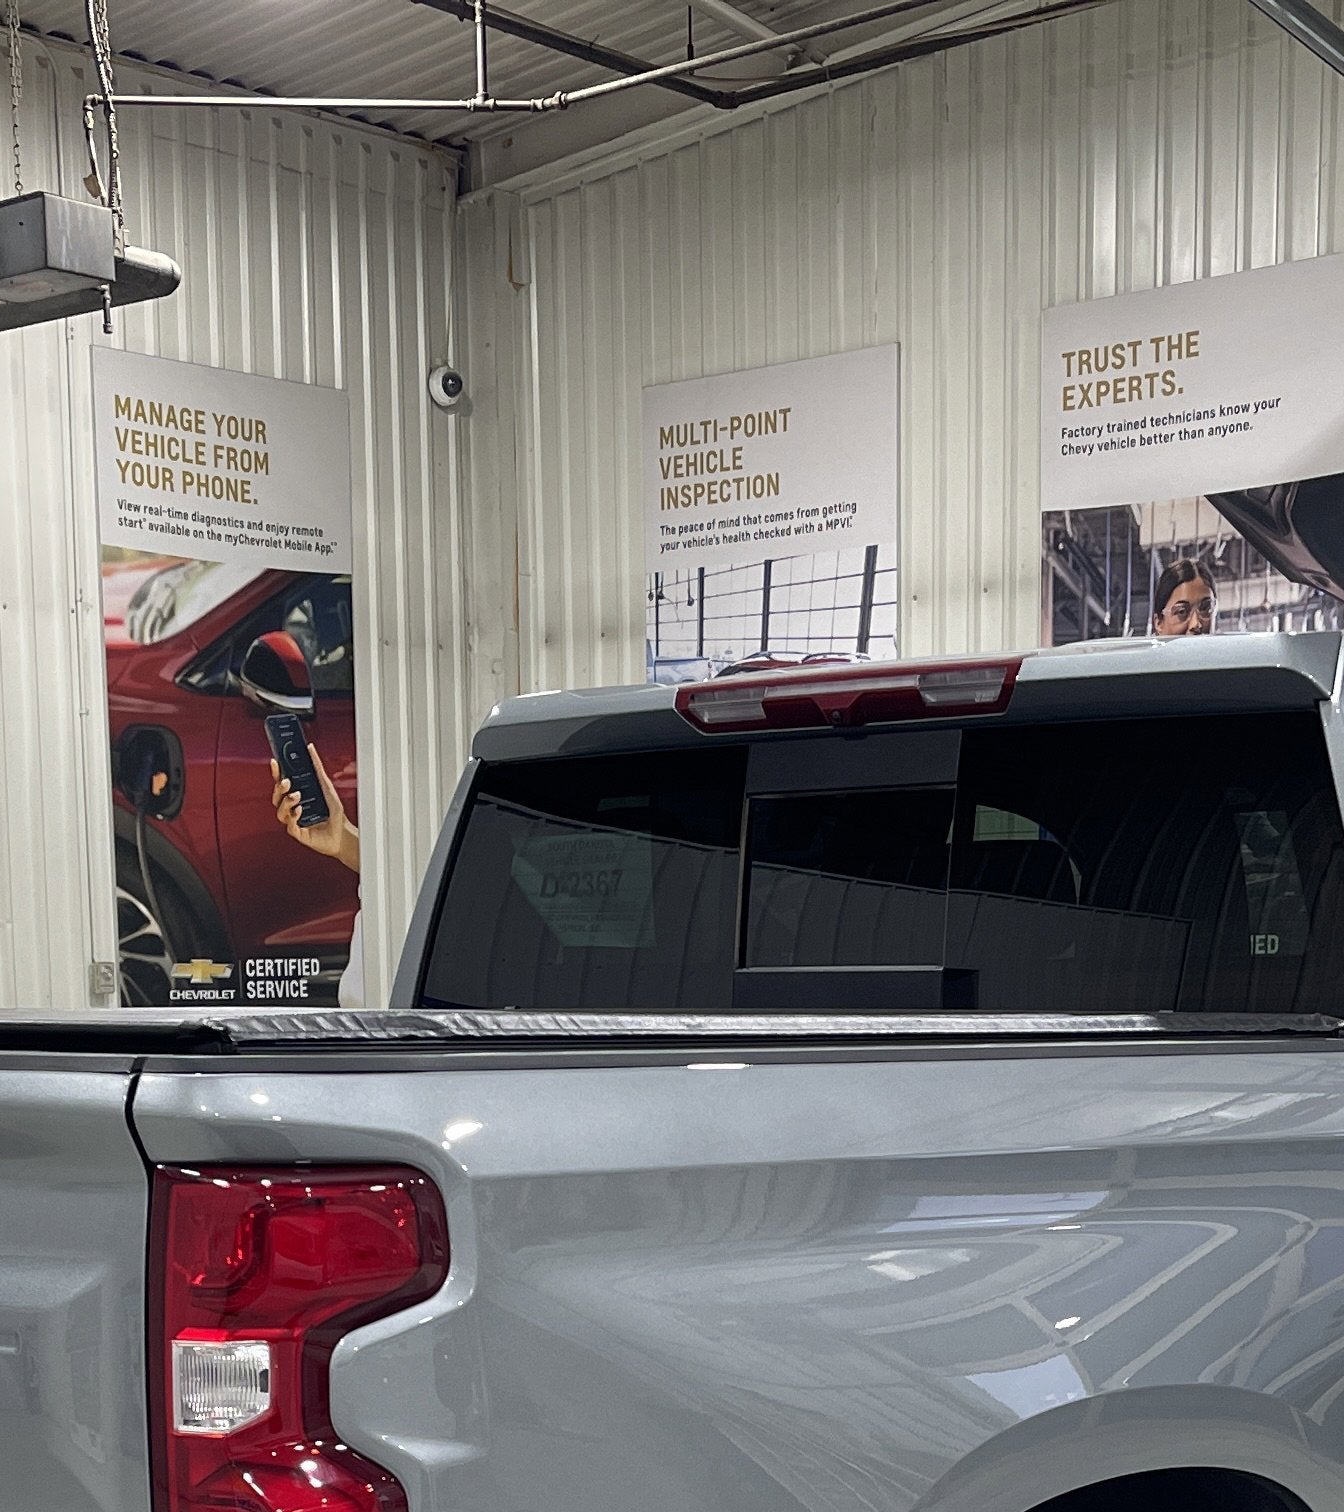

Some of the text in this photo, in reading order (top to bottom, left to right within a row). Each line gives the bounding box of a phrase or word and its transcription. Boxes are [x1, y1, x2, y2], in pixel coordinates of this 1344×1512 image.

[1062, 330, 1200, 378] TRUST THE
[1062, 369, 1184, 412] EXPERTS.
[114, 394, 267, 444] MANAGE YOUR
[660, 407, 792, 450] MULTI-POINT
[1061, 397, 1281, 440] Factory trained technicians know your
[1061, 419, 1254, 456] Chevy vehicle better than anyone.
[115, 426, 269, 476] VEHICLE FROM
[659, 446, 743, 480] VEHICLE
[116, 458, 259, 505] YOUR PHONE.
[660, 472, 780, 511] INSPECTION
[117, 499, 324, 538] View real-time diagnostics and enjoy remote
[148, 521, 190, 538] available
[193, 529, 204, 540] on
[207, 529, 222, 542] the
[225, 533, 282, 549] myChevrolet
[284, 538, 312, 552] Mobile
[660, 502, 857, 537] The peace of mind that comes from getting
[660, 541, 680, 554] your
[722, 530, 751, 545] health
[753, 526, 792, 542] checked
[794, 523, 815, 537] with
[817, 523, 823, 532] a
[245, 958, 320, 977] CERTIFIED
[169, 989, 236, 1001] CHEVROLET
[246, 979, 309, 999] SERVICE
